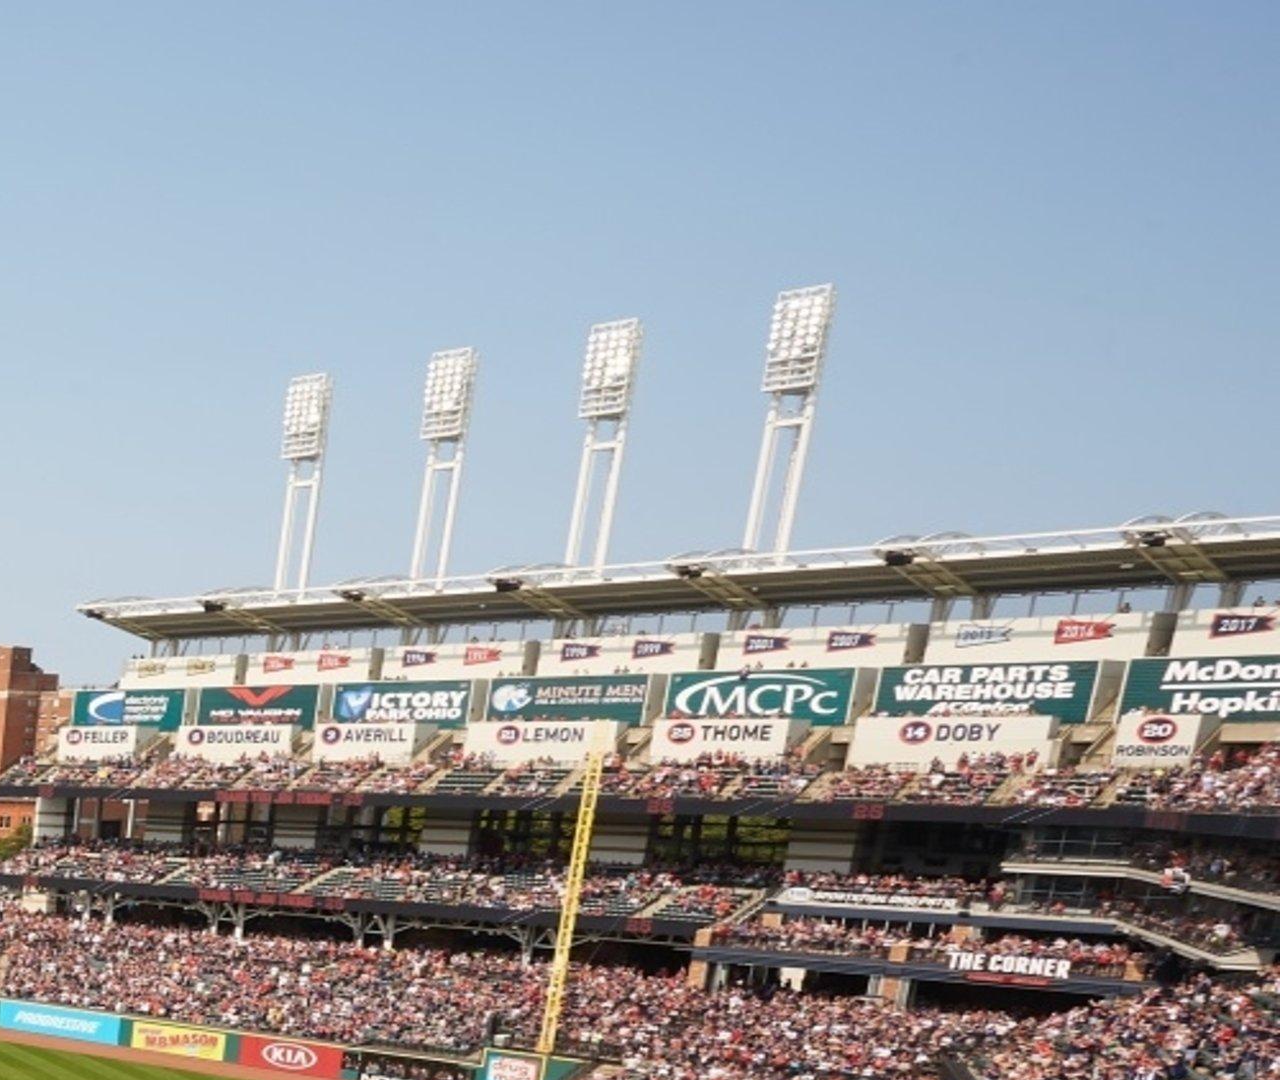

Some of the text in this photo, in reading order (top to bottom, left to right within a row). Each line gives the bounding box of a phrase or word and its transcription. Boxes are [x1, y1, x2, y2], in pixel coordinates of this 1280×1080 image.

[1218, 618, 1258, 632] 2017
[749, 637, 776, 649] 2001
[831, 635, 861, 647] 2007
[903, 665, 1070, 684] CAR PARTS
[535, 684, 646, 698] MINUTE MEN
[894, 682, 1076, 700] WAREHOUSE
[341, 686, 468, 718] VICTORY
[695, 683, 838, 716] MCPc
[413, 707, 462, 720] OHIO
[84, 731, 129, 743] FELLER
[207, 730, 280, 743] BOUDREAU
[343, 728, 407, 742] AVERILL
[523, 728, 585, 742] LEMON
[701, 725, 773, 742] THOME
[905, 726, 928, 739] 14
[935, 724, 1002, 741] DOBY
[1142, 723, 1174, 739] 20
[1116, 744, 1192, 758] ROBINSON
[945, 951, 987, 971] THE
[988, 953, 1072, 980] CORNER
[14, 1010, 102, 1034] PROGRESSIVE
[271, 1048, 307, 1067] KIA
